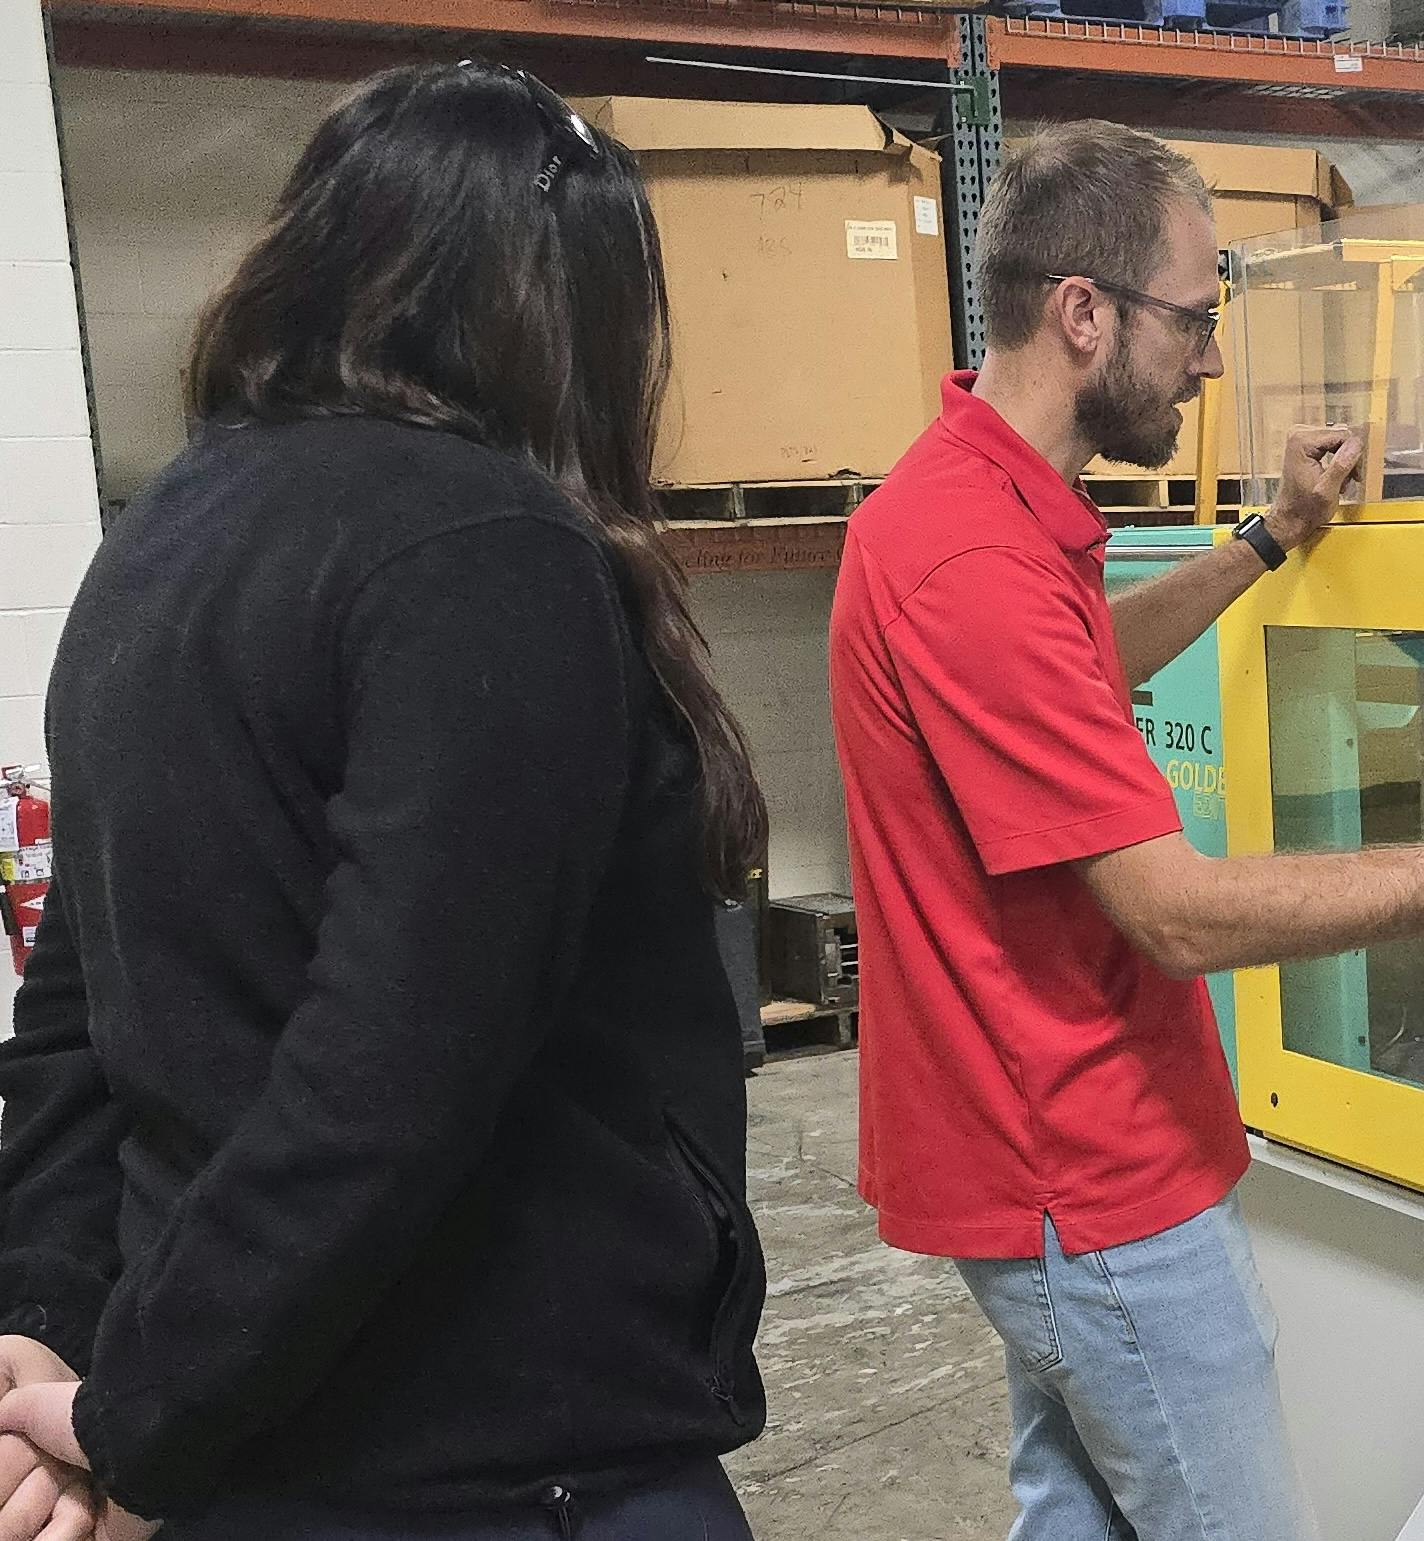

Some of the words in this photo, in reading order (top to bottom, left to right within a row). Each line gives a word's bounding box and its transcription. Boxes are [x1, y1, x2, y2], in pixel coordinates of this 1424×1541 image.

[533, 155, 561, 192] Dior
[1165, 721, 1194, 752] 320
[1201, 726, 1212, 755] C
